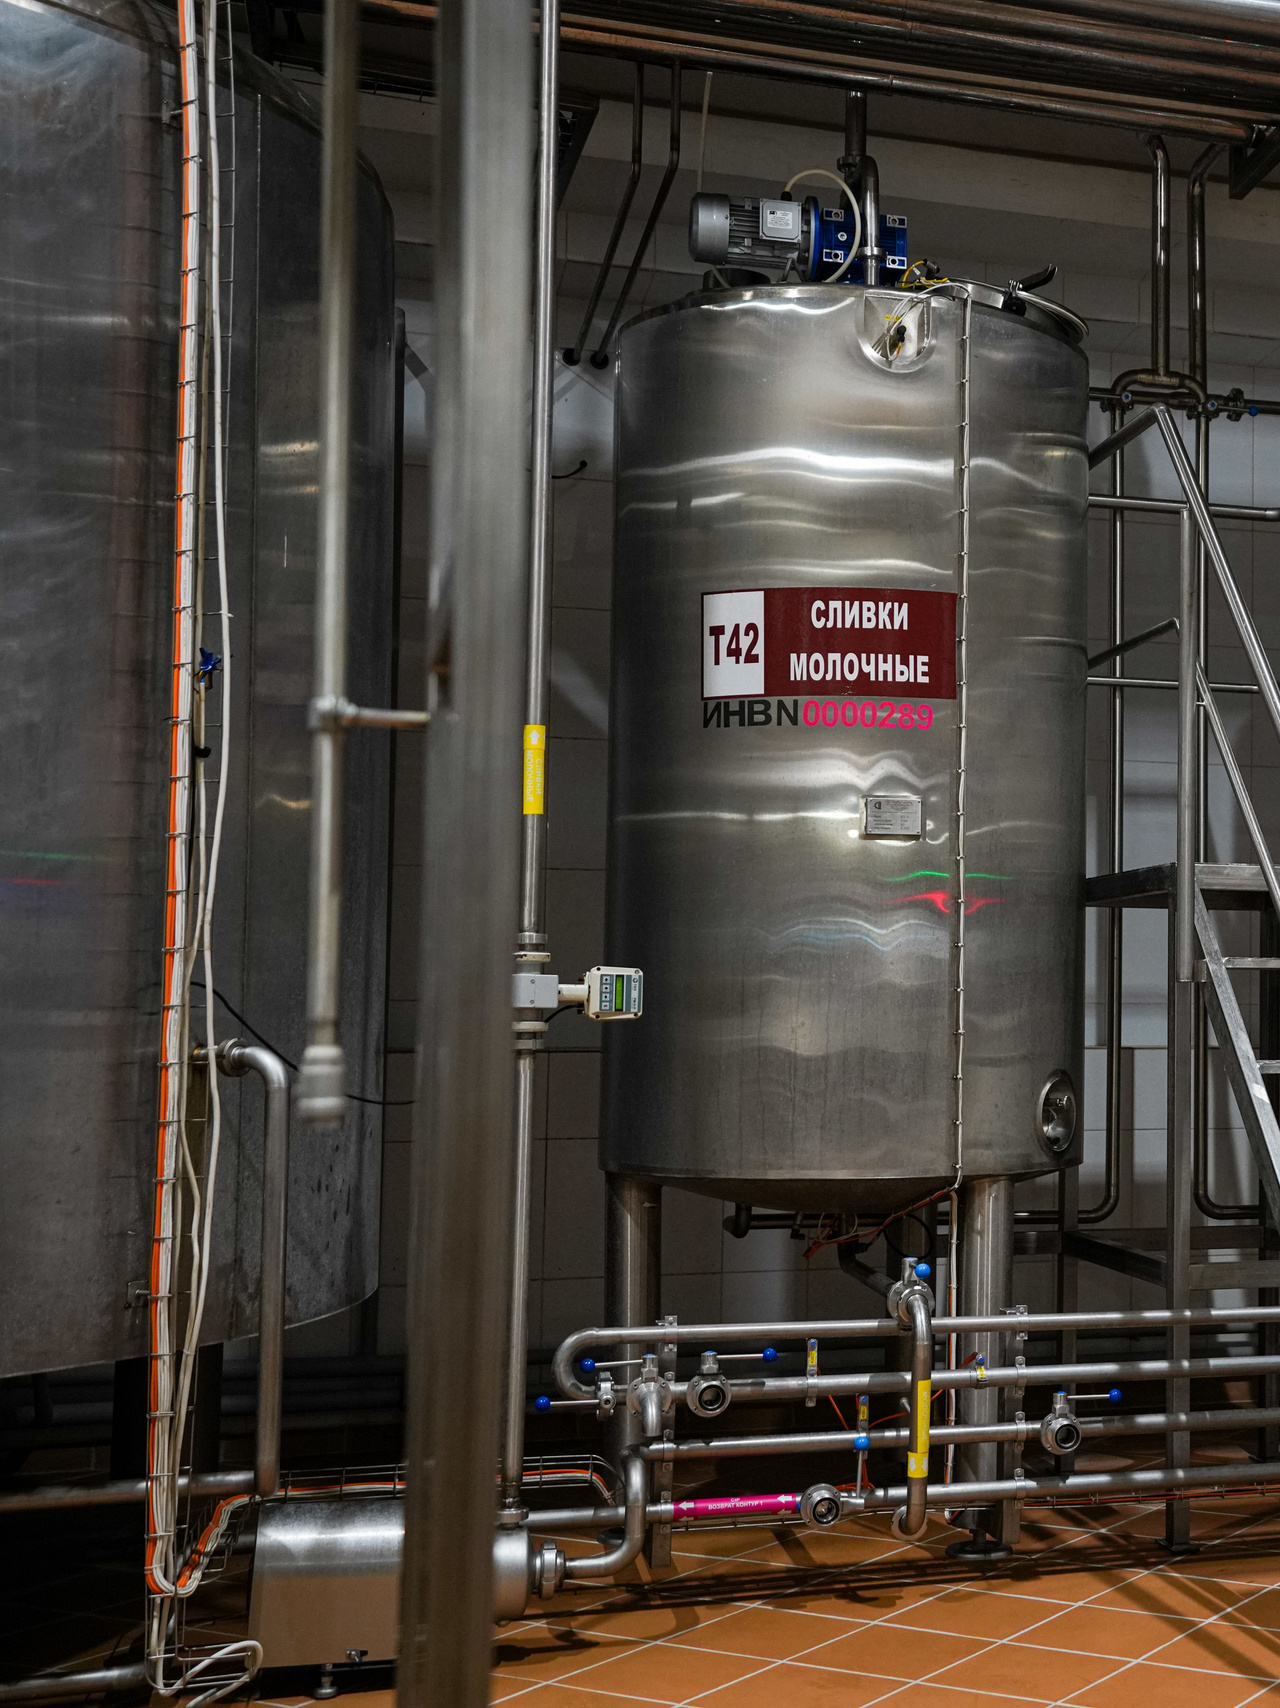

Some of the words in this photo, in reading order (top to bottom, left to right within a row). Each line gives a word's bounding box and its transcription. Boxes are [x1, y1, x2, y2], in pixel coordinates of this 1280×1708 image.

[811, 599, 909, 631] СЛИВКИ
[709, 622, 760, 666] Т42
[789, 653, 930, 684] МОЛОЧНЫЕ
